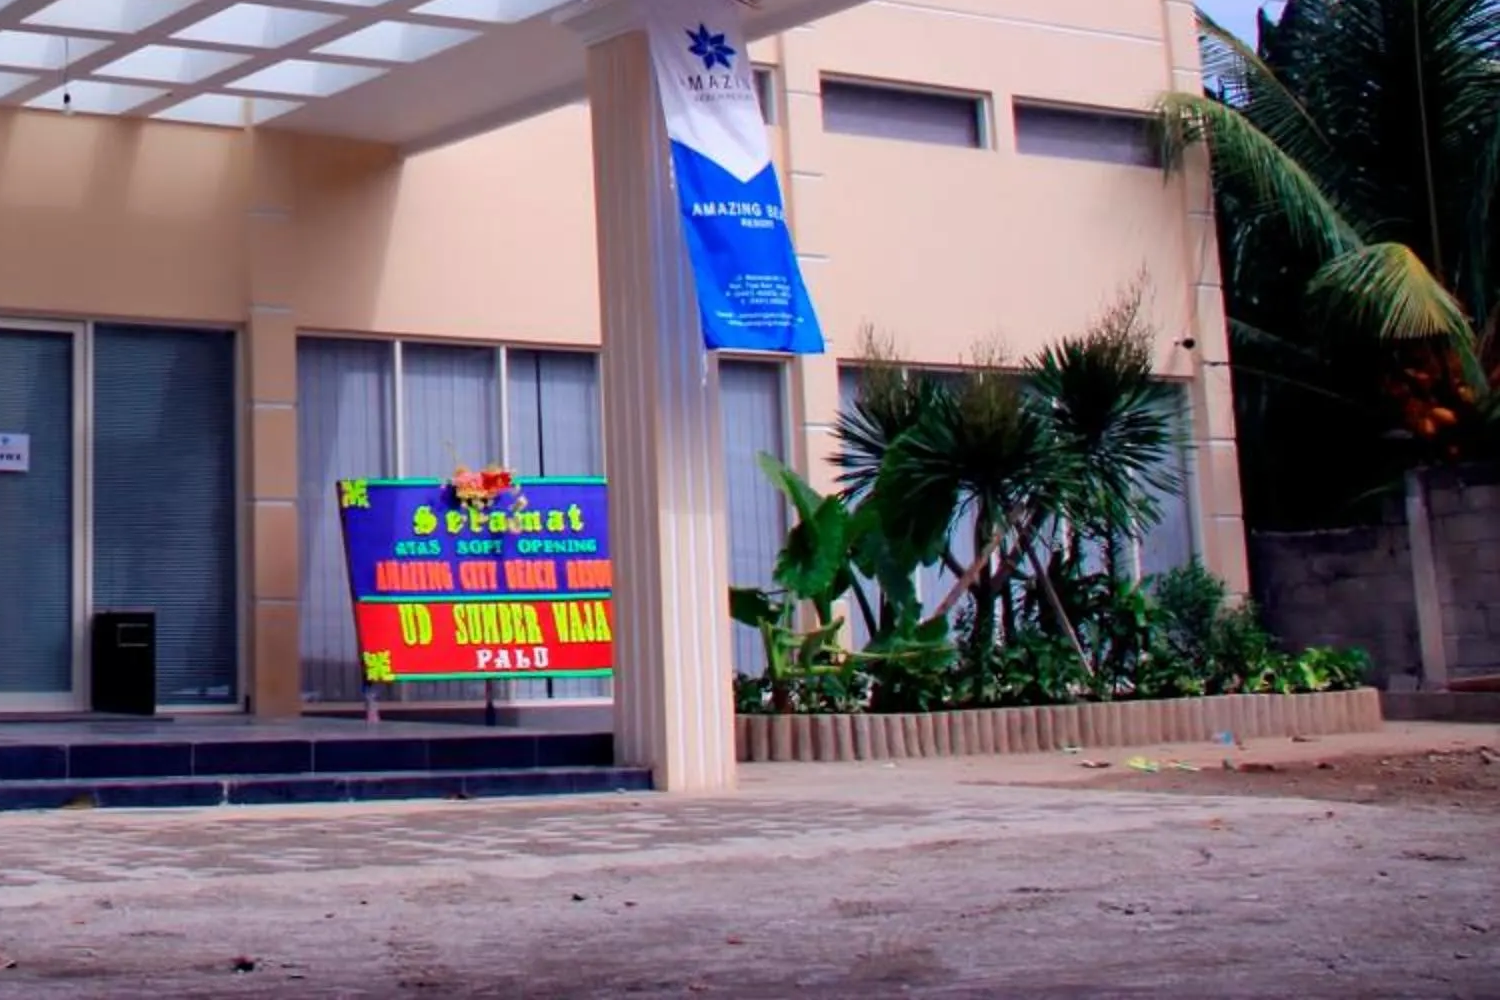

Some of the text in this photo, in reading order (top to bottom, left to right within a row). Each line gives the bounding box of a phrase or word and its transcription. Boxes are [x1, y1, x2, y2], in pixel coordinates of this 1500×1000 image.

[692, 201, 762, 217] AMAZING
[456, 538, 503, 556] SOFT
[517, 537, 598, 554] OPENING
[398, 603, 434, 645] UD
[476, 647, 549, 670] PALU
